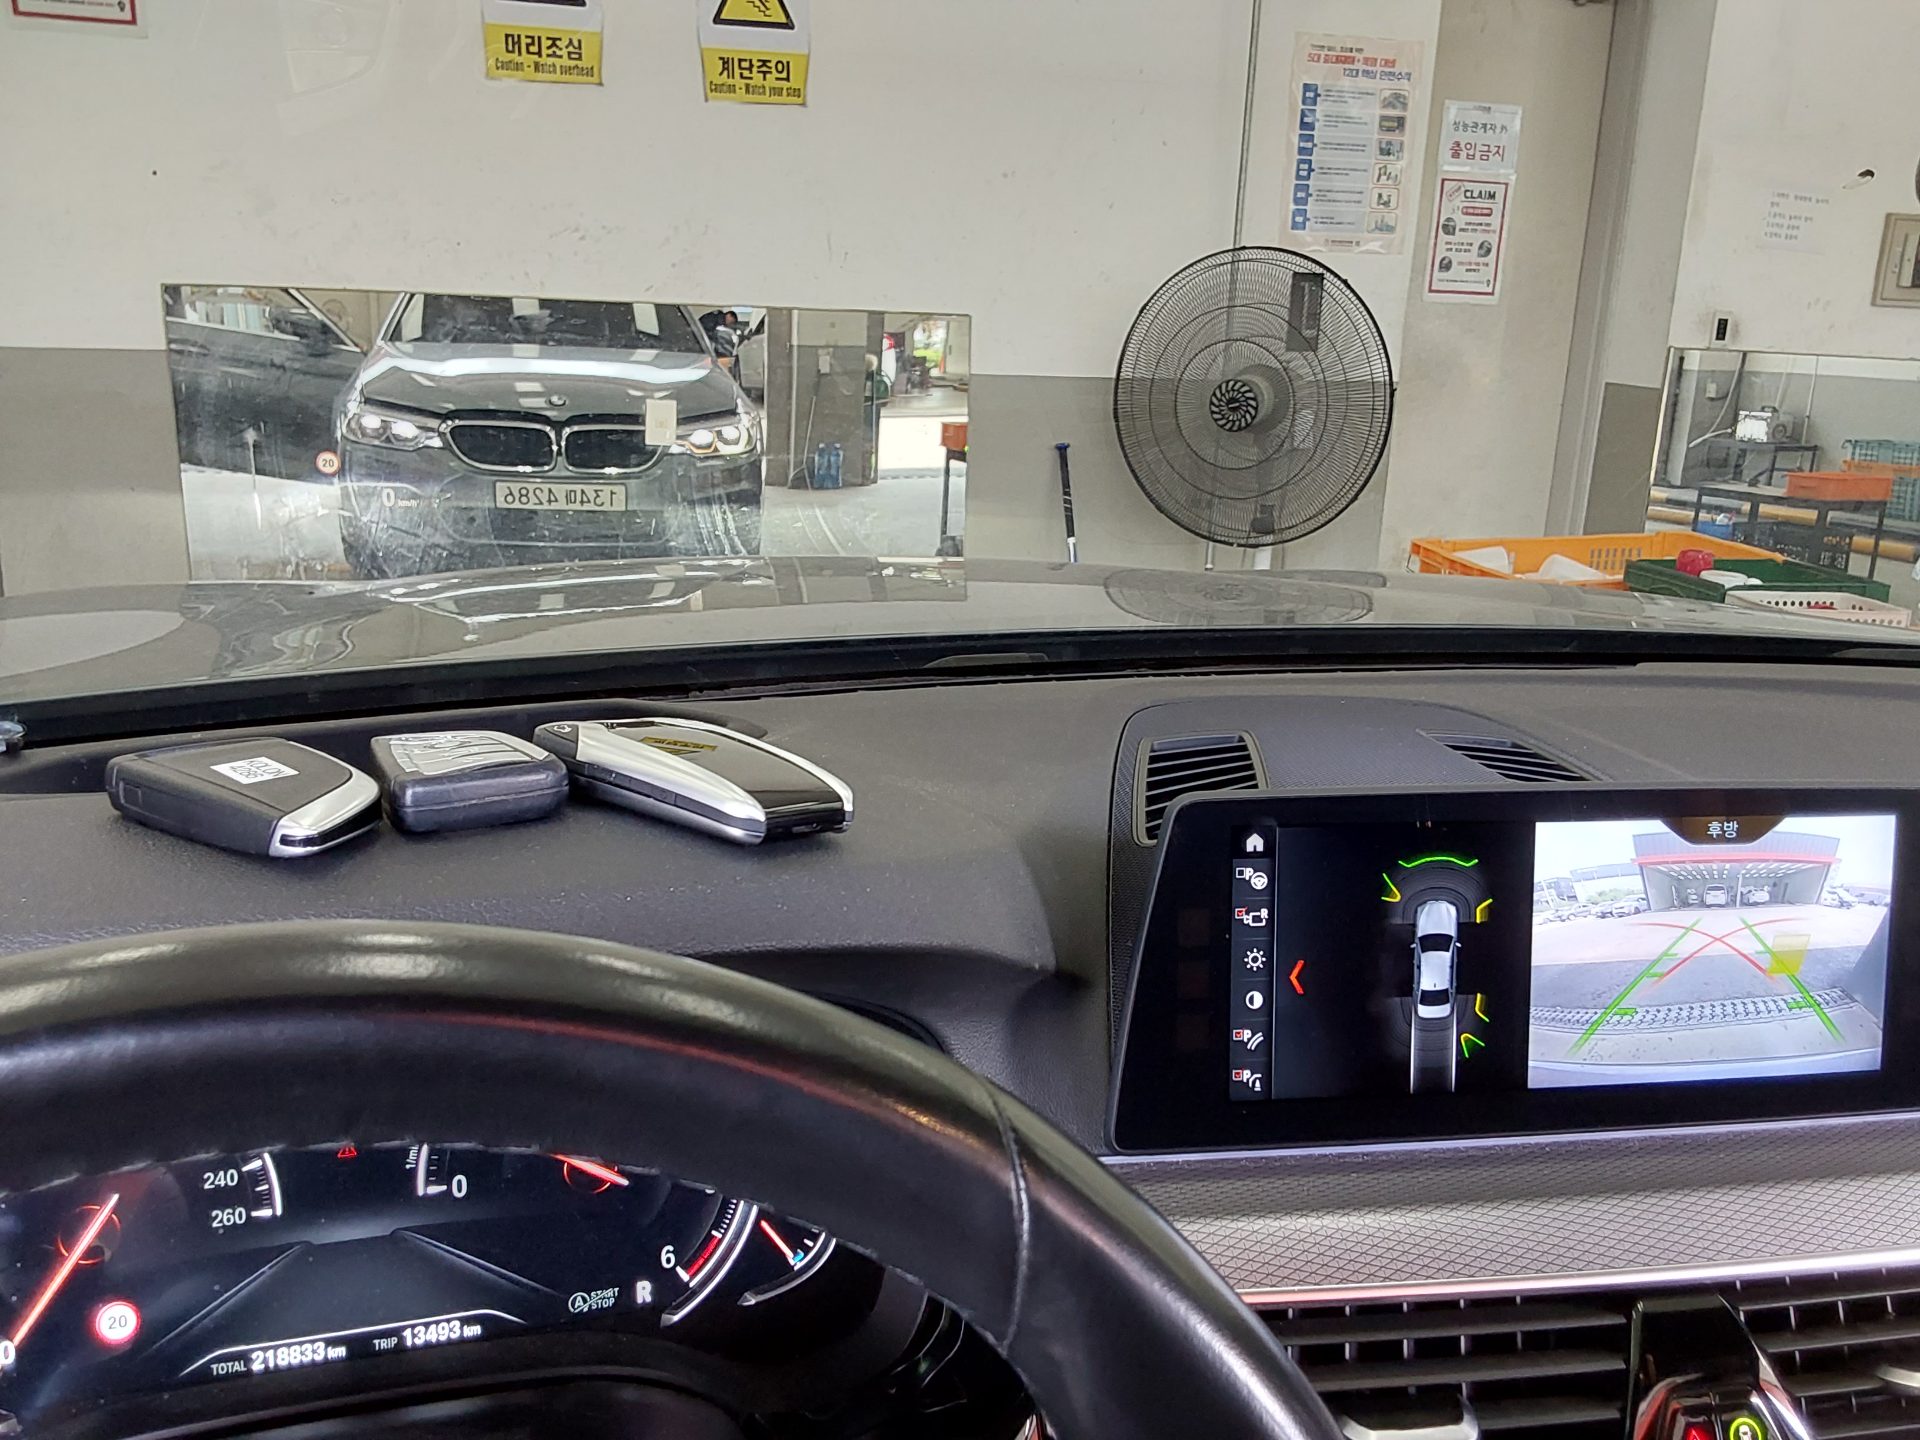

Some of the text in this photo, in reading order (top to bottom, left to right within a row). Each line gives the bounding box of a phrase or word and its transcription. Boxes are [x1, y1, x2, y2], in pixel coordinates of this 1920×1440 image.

[504, 33, 583, 62] 머리조심
[495, 57, 525, 72] Caution
[533, 60, 557, 74] Watch
[560, 64, 594, 77] overhead
[718, 56, 791, 83] 계단주의
[709, 80, 736, 94] Caution
[744, 83, 766, 96] Watch
[768, 86, 784, 98] your
[786, 86, 802, 99] step
[1449, 140, 1506, 163] 출입금지
[1463, 189, 1496, 201] CLAIM
[321, 458, 335, 468] 20
[381, 487, 396, 507] 0
[1706, 820, 1739, 839] 후방
[405, 1144, 419, 1170] 1/mi
[203, 1168, 239, 1189] 240
[451, 1174, 468, 1198] 0
[211, 1207, 247, 1228] 260
[660, 1245, 676, 1269] 6
[591, 1287, 619, 1299] START
[635, 1280, 652, 1304] R
[591, 1298, 615, 1310] STOP
[108, 1315, 127, 1330] 20
[372, 1319, 482, 1351] TRIP 13493 km
[210, 1341, 347, 1376] TOTAL 218833 km
